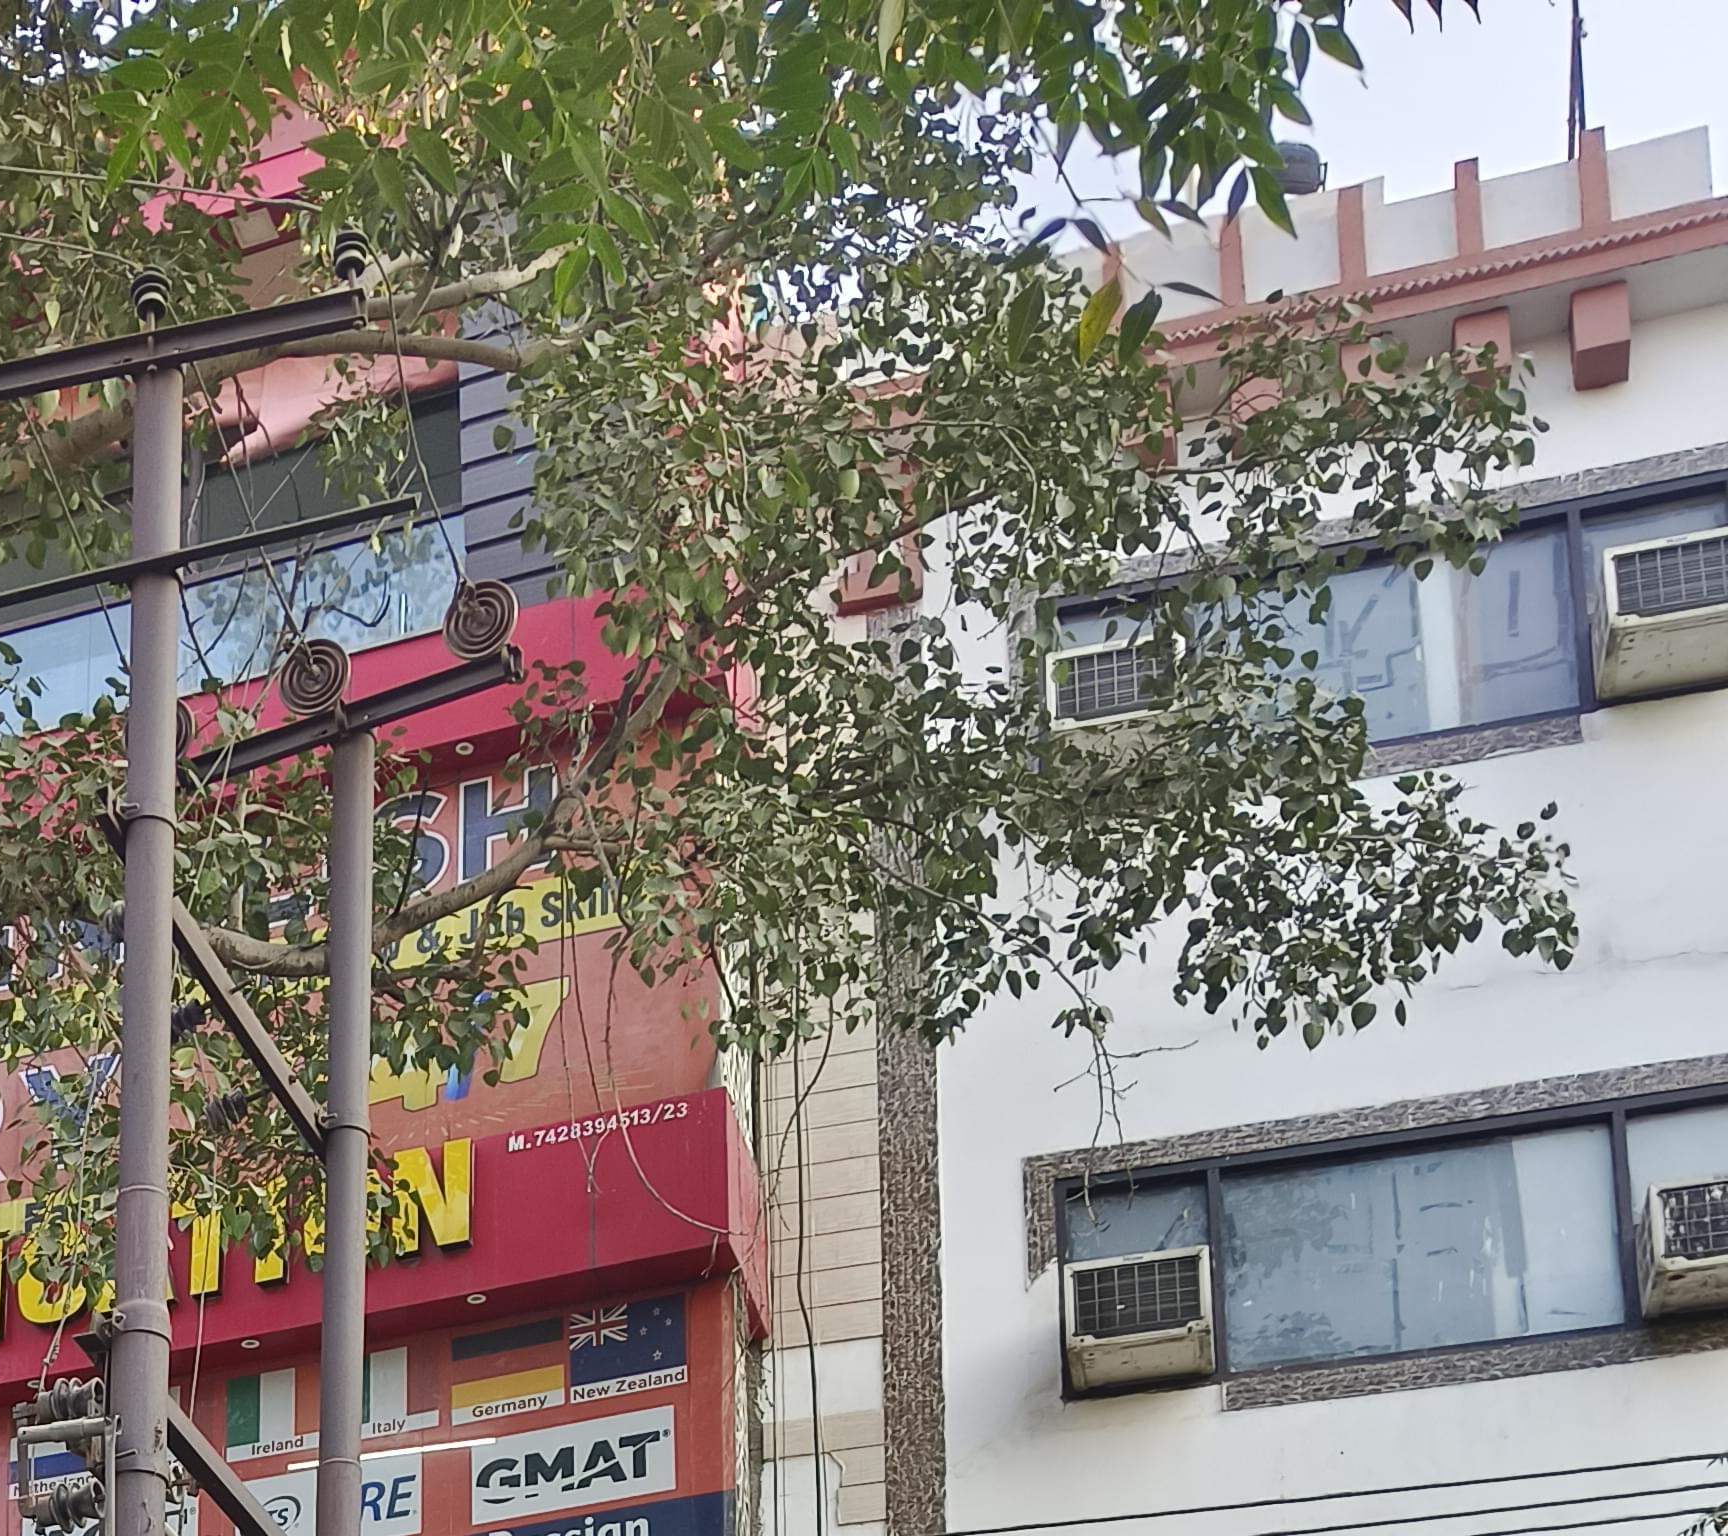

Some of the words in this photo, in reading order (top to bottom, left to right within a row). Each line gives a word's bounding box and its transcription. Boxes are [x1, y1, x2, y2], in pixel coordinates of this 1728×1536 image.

[540, 877, 619, 928] Skill
[573, 1382, 609, 1401] New
[615, 1366, 686, 1395] Zealand
[472, 1394, 548, 1419] Germany
[371, 1416, 406, 1436] Italy
[475, 1429, 662, 1505] GMAT
